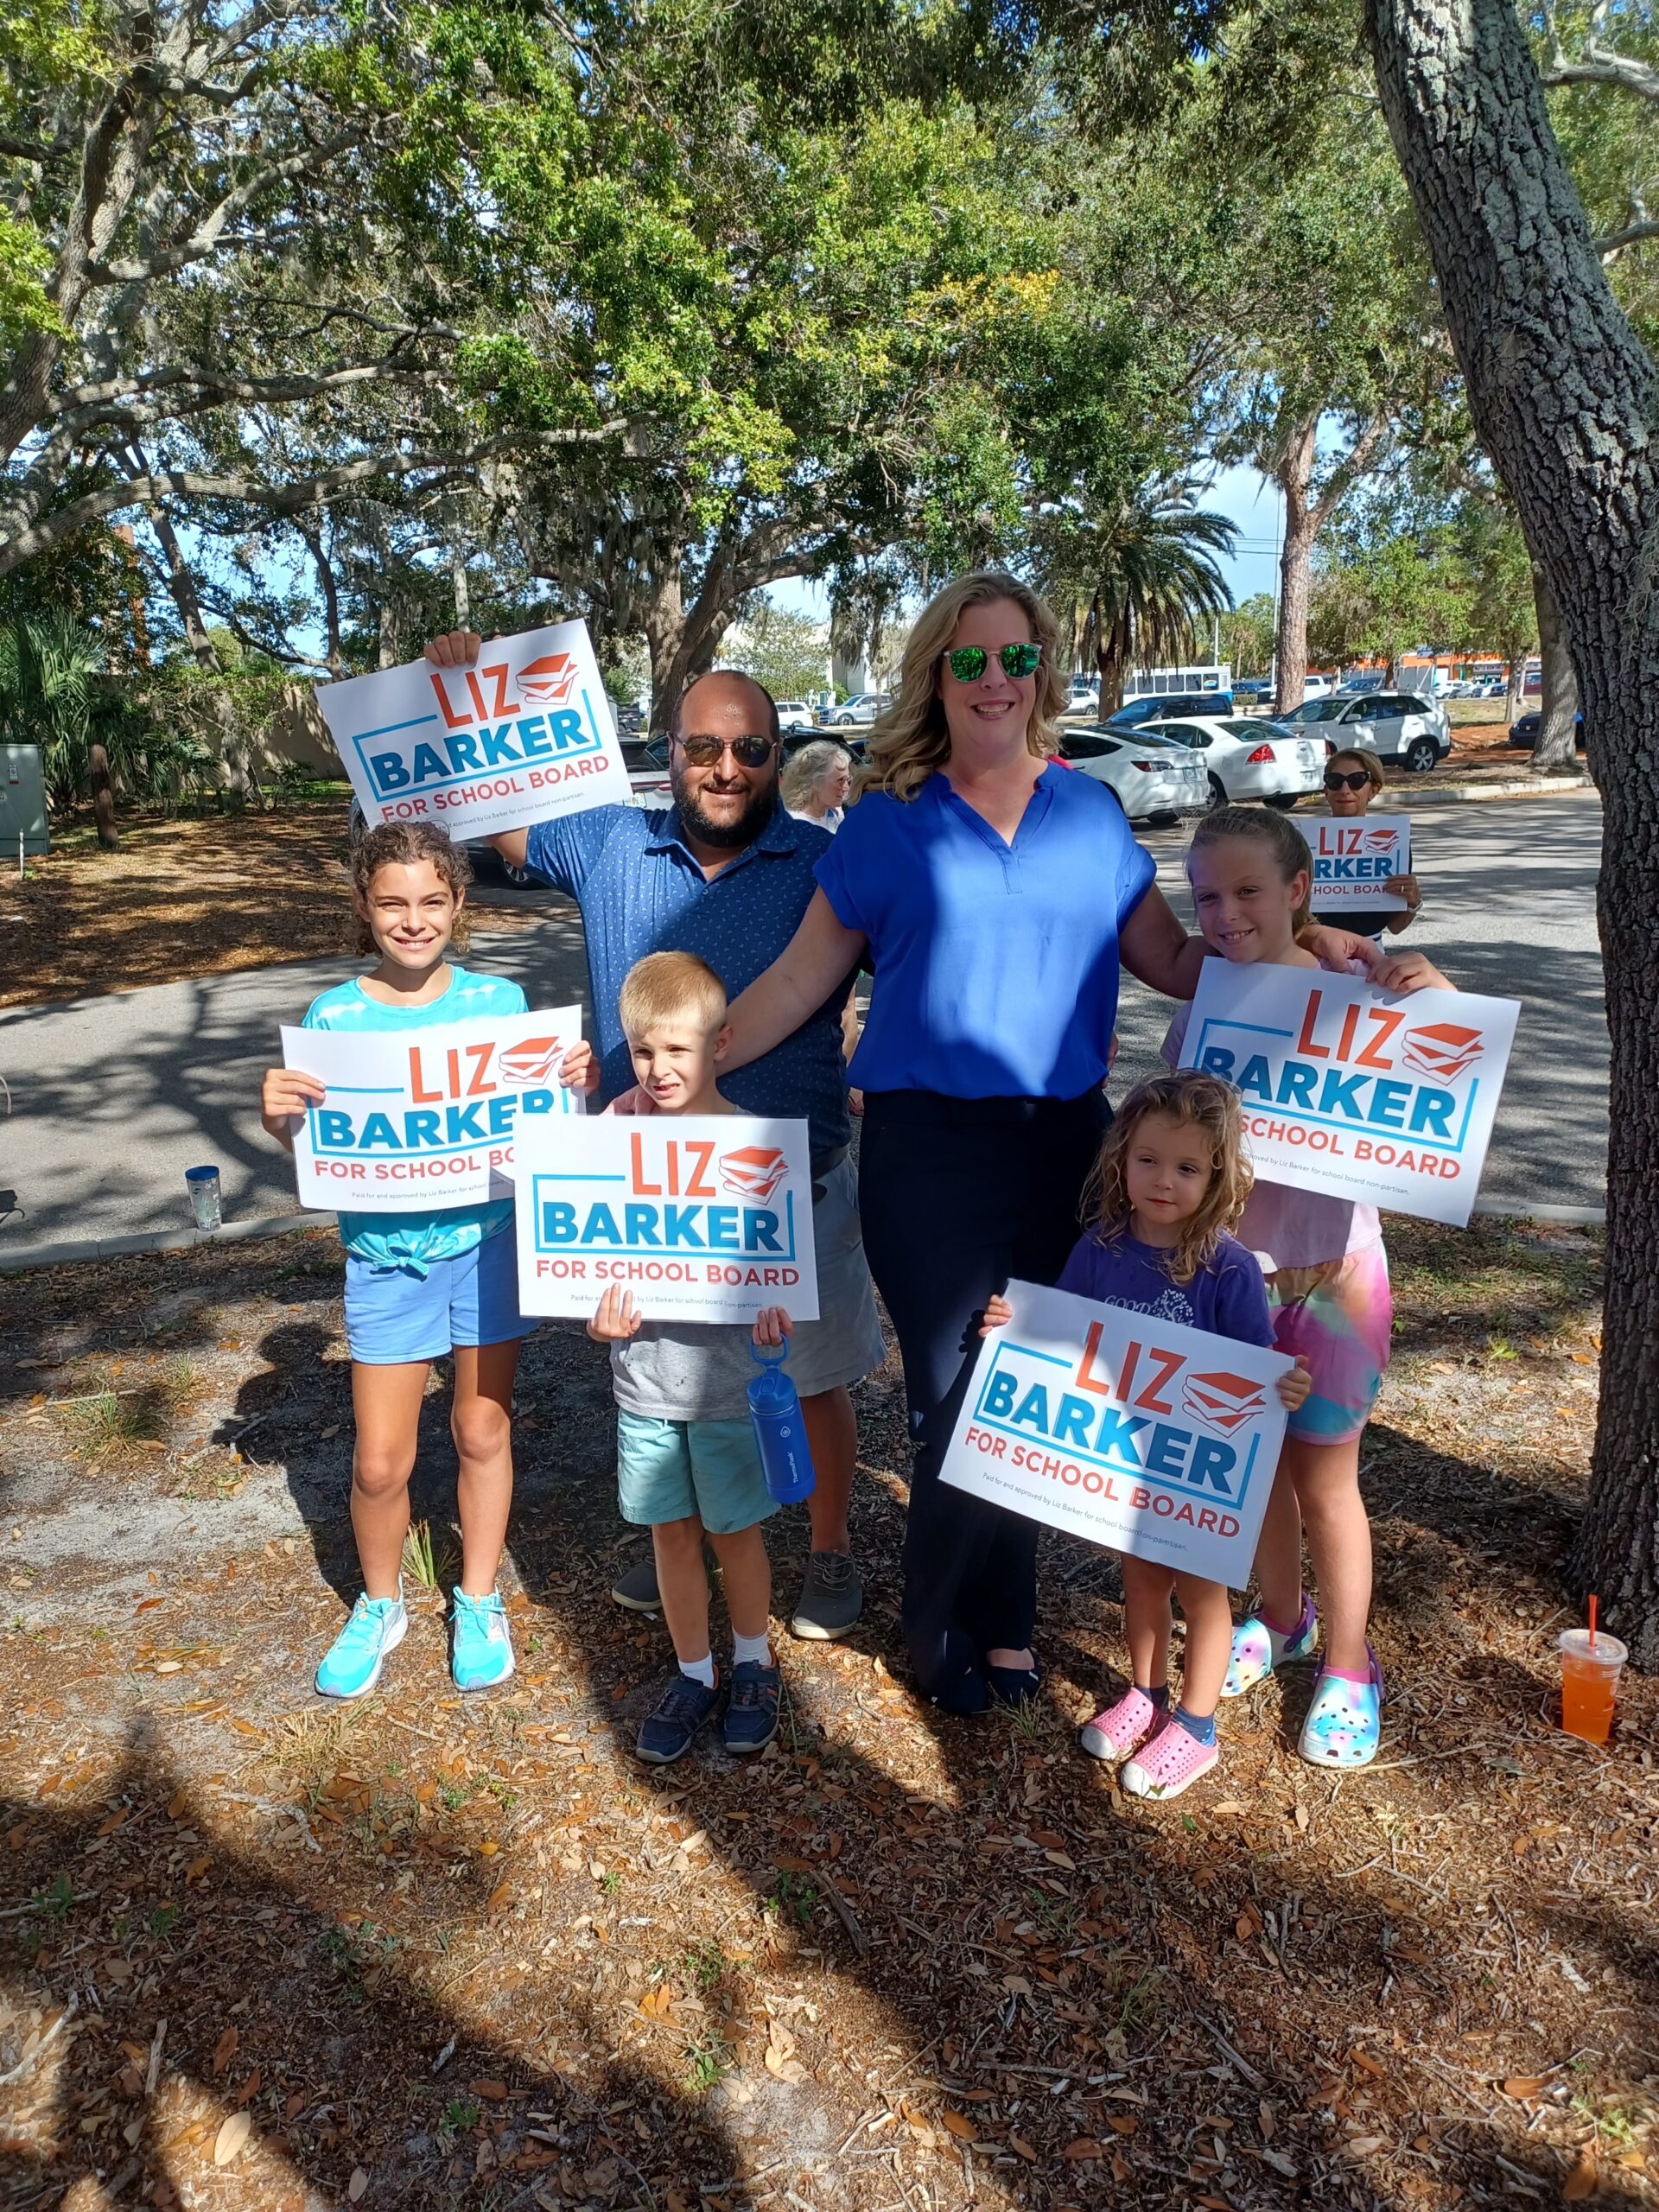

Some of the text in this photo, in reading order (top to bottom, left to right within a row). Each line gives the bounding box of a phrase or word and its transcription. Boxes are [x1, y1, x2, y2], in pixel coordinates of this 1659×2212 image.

[430, 664, 520, 728] LIZ
[370, 709, 591, 791] BARKER
[381, 756, 609, 822] FOR SCHOOL BOARD
[492, 810, 508, 819] Barker
[518, 804, 535, 813] school
[535, 800, 550, 809] board
[1314, 857, 1393, 878] RKER
[1319, 827, 1363, 855] LIZ
[1313, 885, 1385, 894] HOOL BOA
[1297, 989, 1406, 1071] LIZ
[409, 1042, 497, 1103] LIZ
[1201, 1046, 1457, 1139] BARKER
[315, 1160, 366, 1179] FOR
[375, 1155, 481, 1179] SCHOOL
[631, 1133, 716, 1197] LIZ
[1239, 1114, 1461, 1179] SCHOOL BOARD
[1270, 1157, 1279, 1166] by
[1289, 1162, 1309, 1172] Barker
[1311, 1166, 1321, 1175] for
[1322, 1169, 1344, 1180] school
[1344, 1173, 1365, 1185] board
[543, 1202, 784, 1251] BARKER
[537, 1260, 800, 1287] FOR SCHOOL BOARD
[1075, 1320, 1187, 1415] LIZ
[982, 1370, 1237, 1495] BARKER
[964, 1427, 1241, 1538] FOR SCHOOL BOARD
[982, 1472, 995, 1482] Paid
[1014, 1486, 1043, 1501] approved
[1043, 1496, 1051, 1505] by
[1062, 1503, 1084, 1516] Barker
[1084, 1510, 1094, 1519] for
[1095, 1516, 1118, 1528] school
